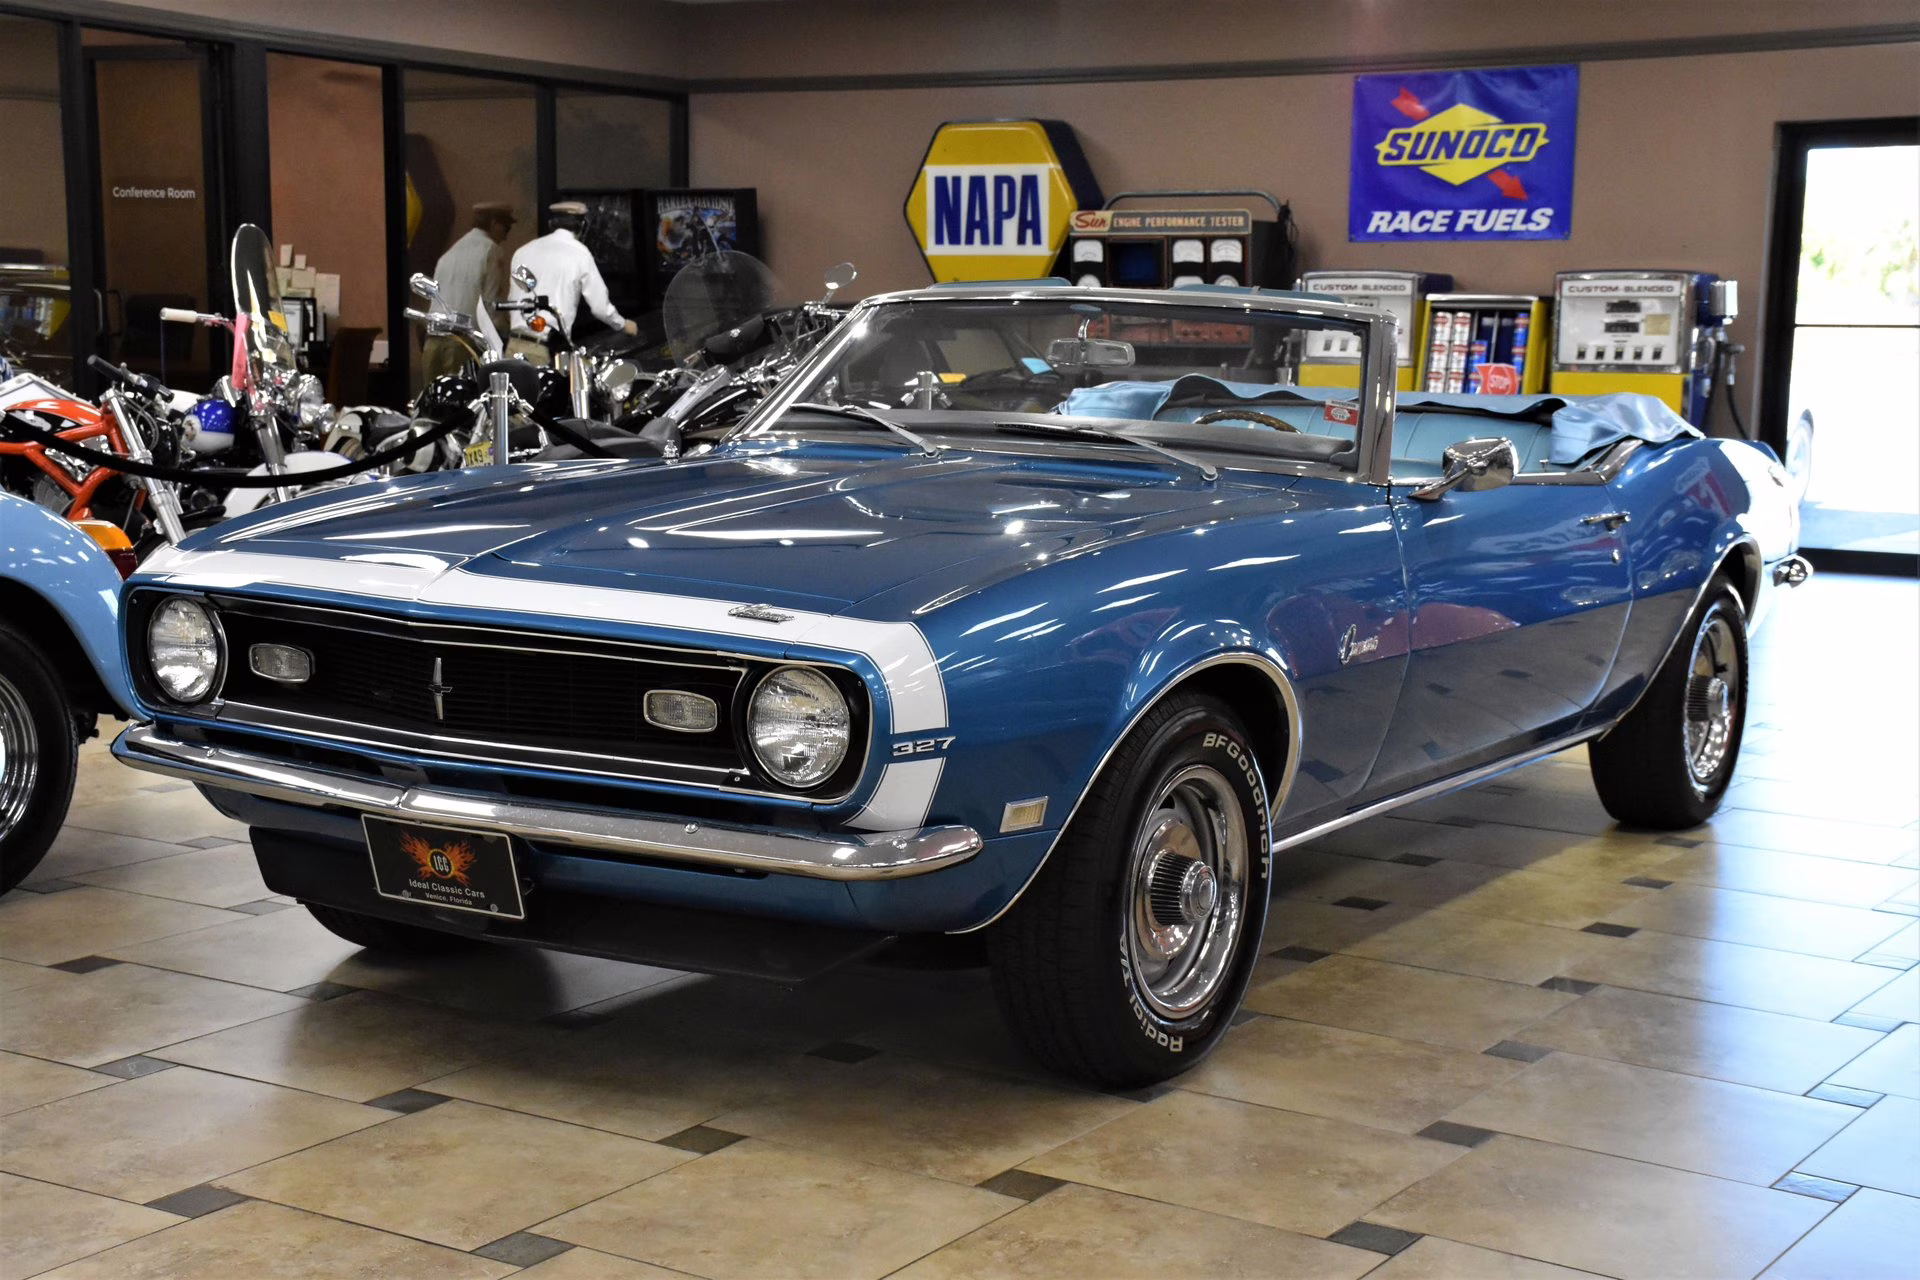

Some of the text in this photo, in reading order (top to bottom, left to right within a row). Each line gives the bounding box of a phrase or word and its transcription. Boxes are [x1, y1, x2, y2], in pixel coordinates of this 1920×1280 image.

[1383, 127, 1541, 161] SUNOCO
[112, 186, 196, 199] Conference Room
[934, 174, 1042, 246] NAPA
[1075, 211, 1109, 230] Sun
[1113, 215, 1245, 228] ENGINE PERFORMANCE TESTER
[1367, 208, 1555, 234] RACE FUELS
[892, 736, 957, 757] 327
[1203, 733, 1271, 880] BFGoodrich
[433, 854, 450, 873] ICC
[408, 879, 486, 899] Ideal Classic Cars
[449, 896, 473, 906] Florida
[1129, 994, 1184, 1052] Radial
